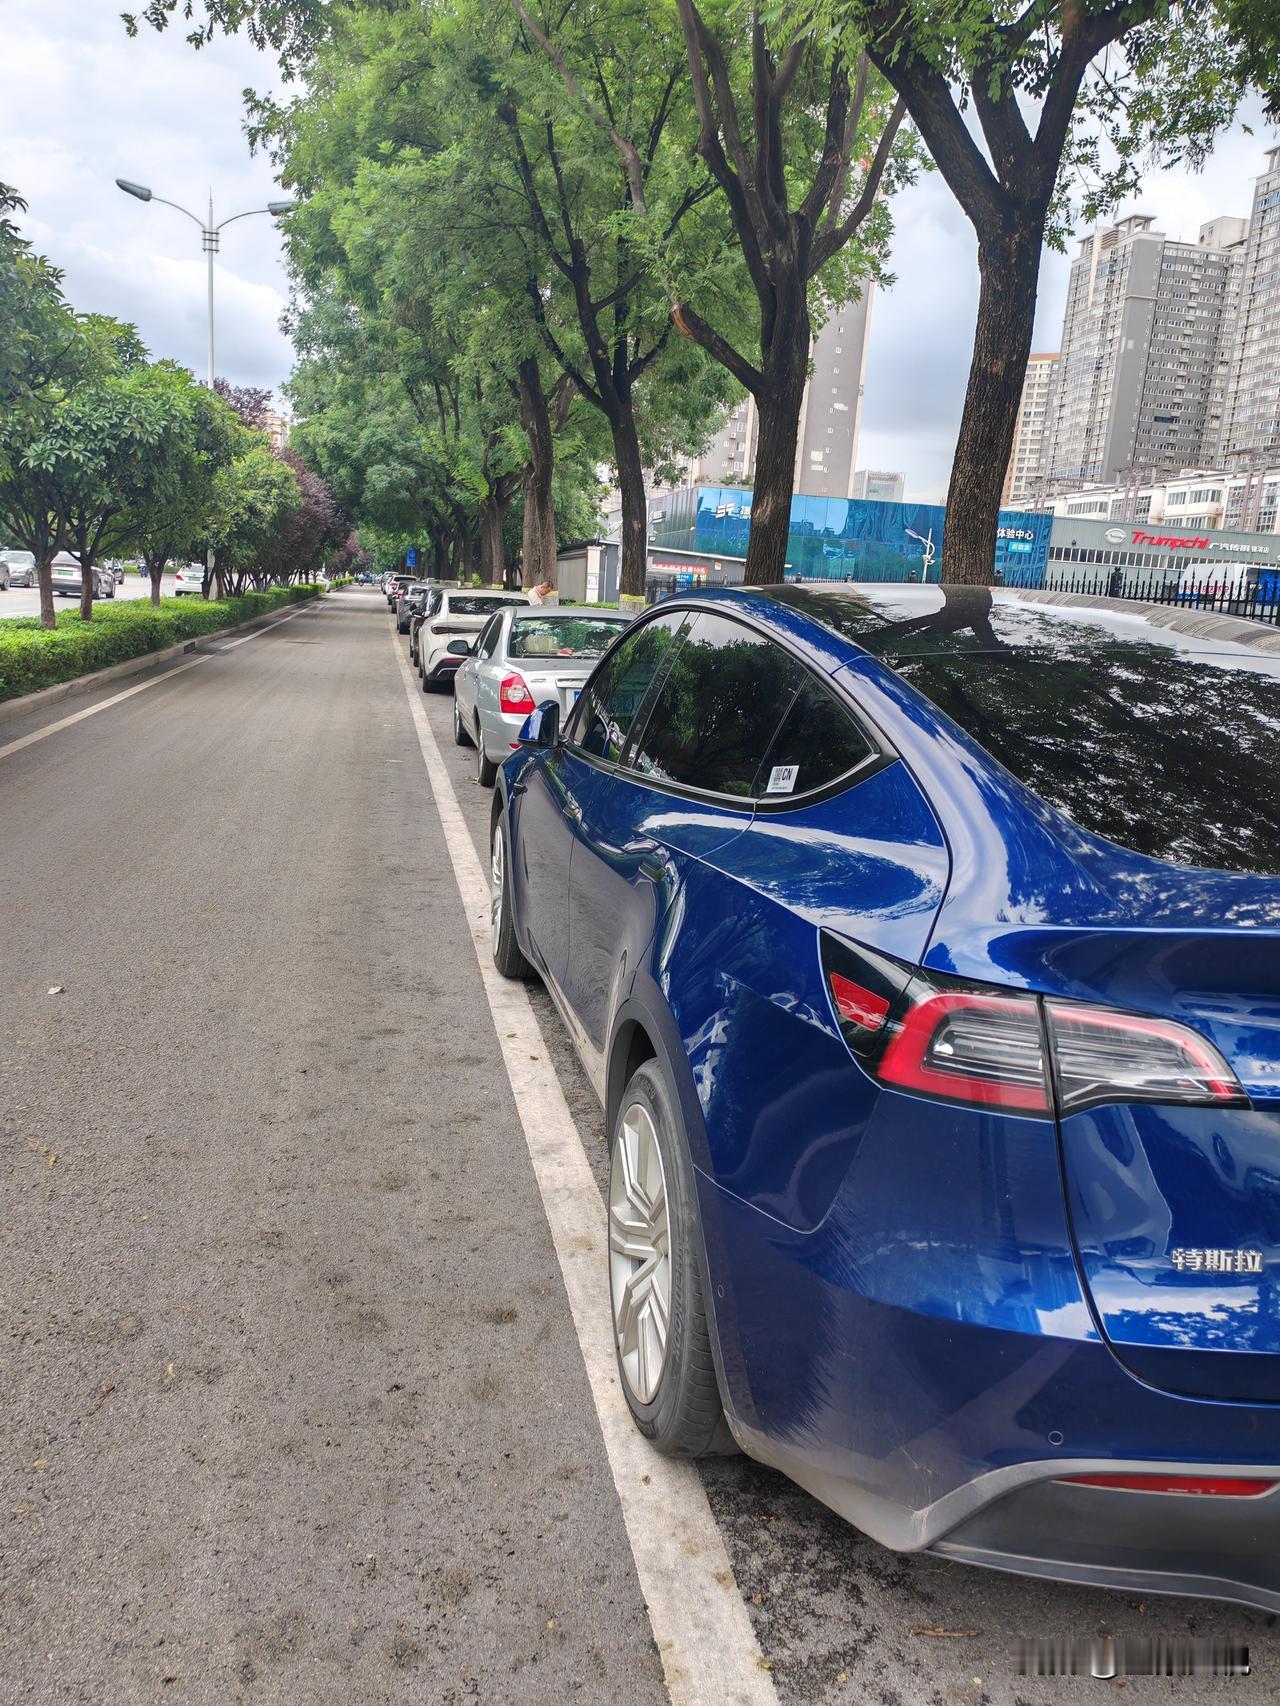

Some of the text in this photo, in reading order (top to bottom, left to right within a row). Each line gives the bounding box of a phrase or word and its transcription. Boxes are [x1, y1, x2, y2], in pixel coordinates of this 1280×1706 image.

[997, 527, 1034, 540] 体验中心
[1131, 529, 1211, 551] Trumpchi
[1171, 1248, 1263, 1273] 特斯拉
